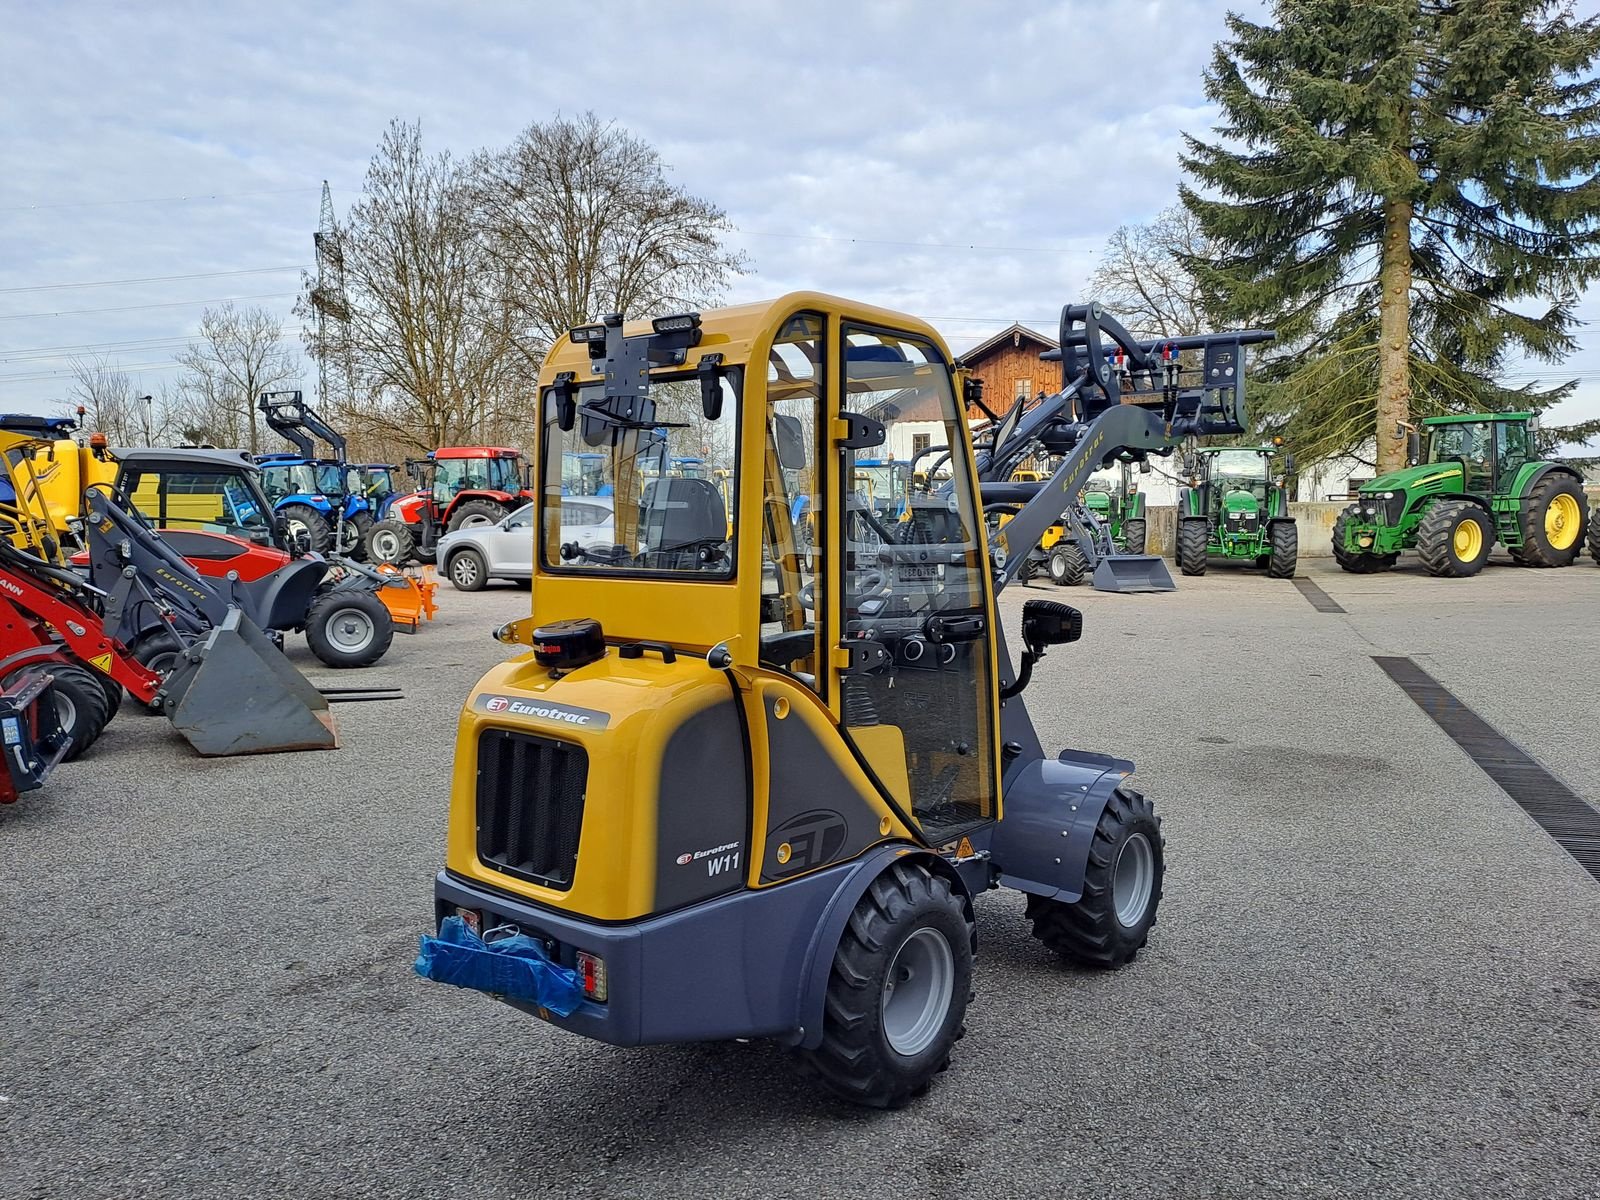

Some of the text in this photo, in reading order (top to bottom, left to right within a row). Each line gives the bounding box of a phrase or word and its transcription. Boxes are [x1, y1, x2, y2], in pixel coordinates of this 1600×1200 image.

[1063, 431, 1104, 492] Eurotrac
[156, 569, 206, 599] Eurotrac
[486, 697, 590, 725] ET Eurotrac
[693, 842, 740, 859] Eurotrac
[708, 852, 739, 877] W11
